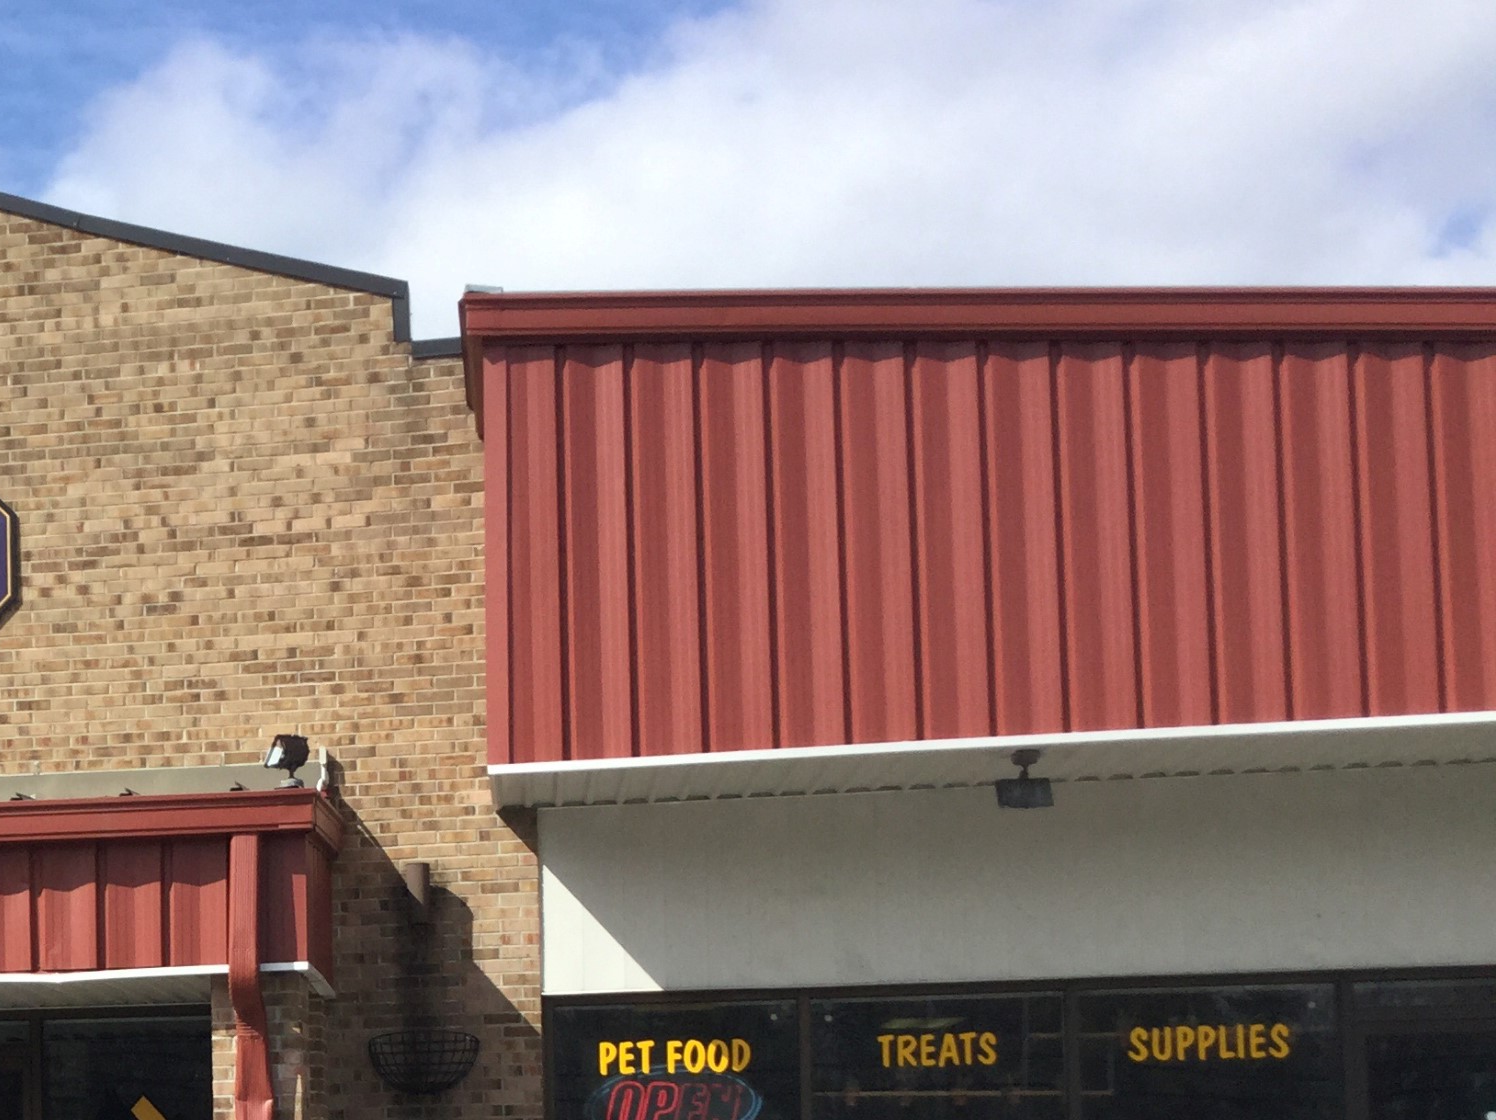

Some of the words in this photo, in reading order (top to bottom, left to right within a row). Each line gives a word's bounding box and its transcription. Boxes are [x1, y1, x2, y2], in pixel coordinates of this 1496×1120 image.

[599, 1040, 655, 1076] PET
[667, 1038, 752, 1074] FOOD
[877, 1031, 998, 1067] TREATS
[1128, 1023, 1291, 1061] SUPPLIES
